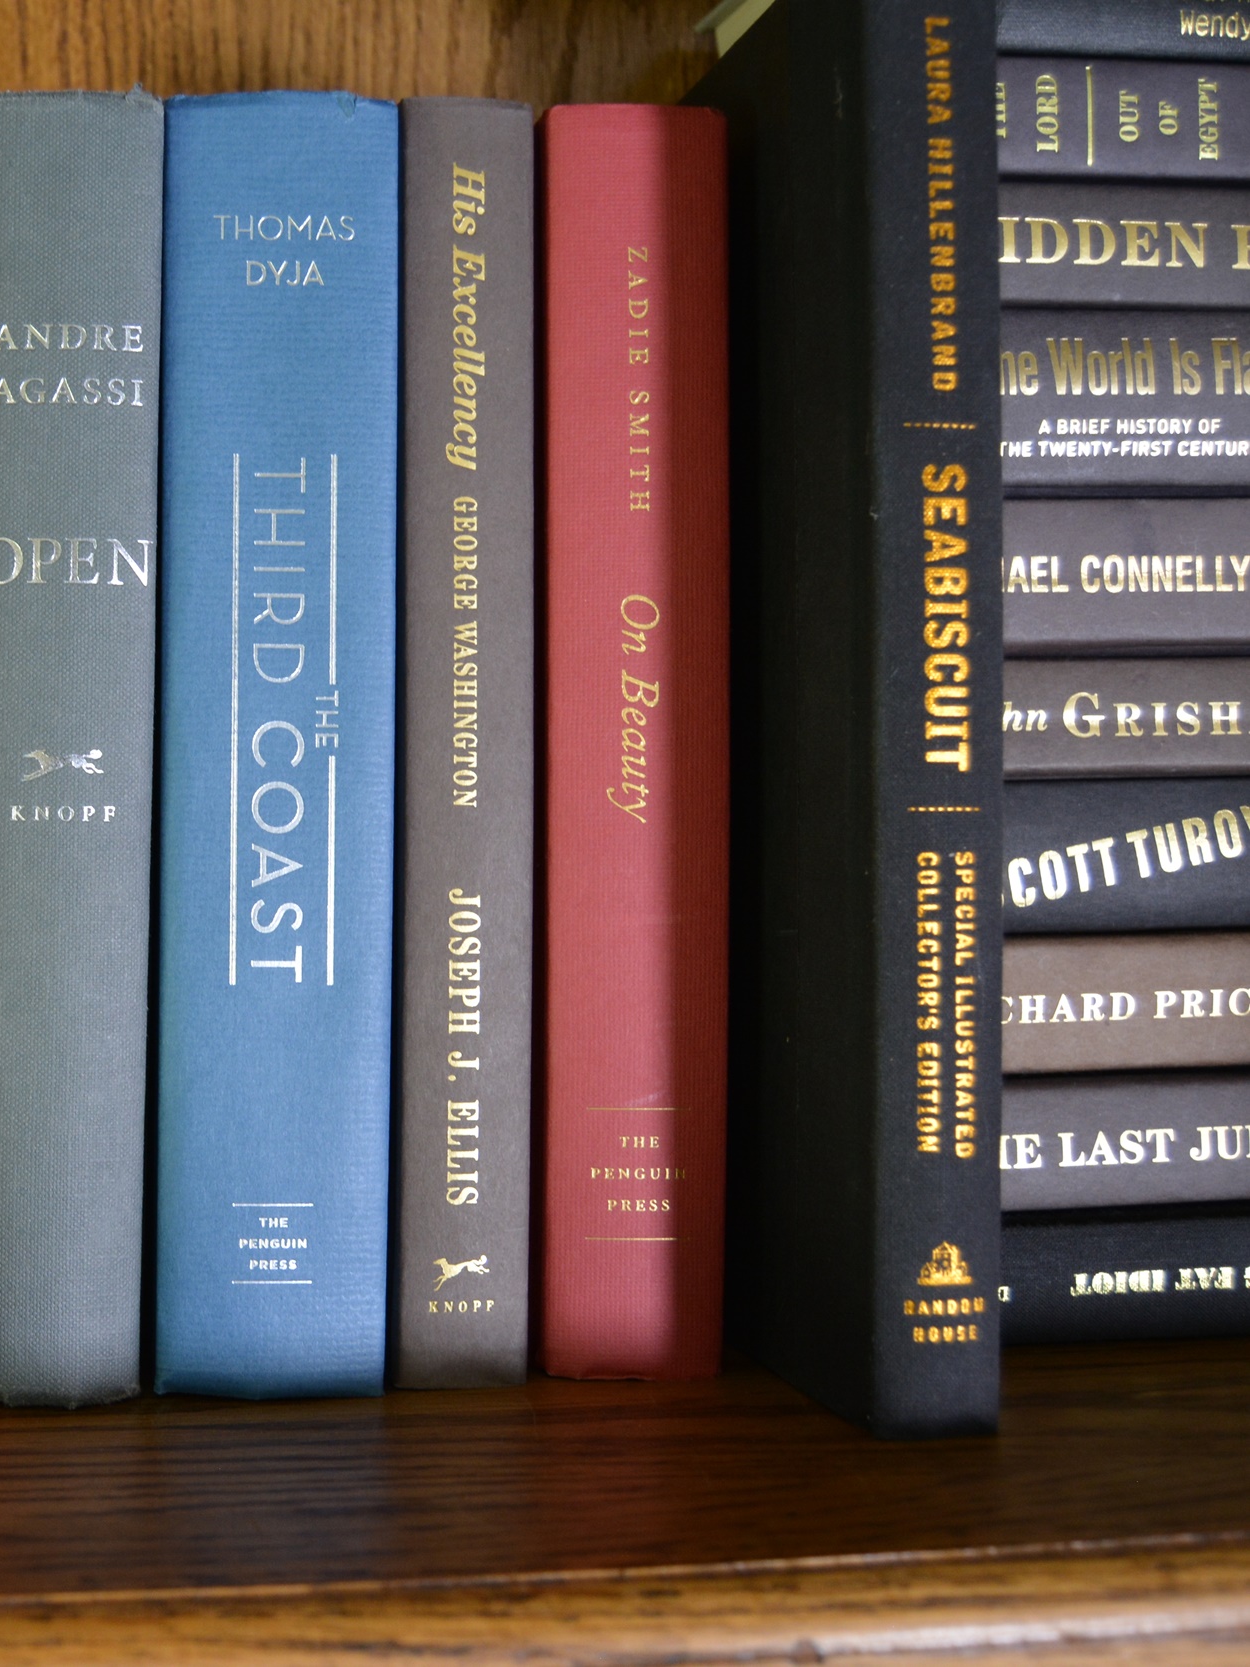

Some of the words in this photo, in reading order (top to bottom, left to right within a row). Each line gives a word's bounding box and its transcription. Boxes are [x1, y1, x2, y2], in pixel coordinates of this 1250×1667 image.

[1181, 11, 1250, 41] Wendy
[924, 16, 953, 125] LAURA
[1036, 74, 1059, 152] LORD
[1119, 90, 1140, 142] OUT
[1159, 101, 1178, 135] OF
[1198, 78, 1220, 160] EGYPT
[451, 161, 486, 236] His
[214, 215, 355, 241] THOMAS
[998, 216, 1208, 268] IDDEN
[246, 260, 324, 286] DYJA
[927, 137, 959, 392] HILLENBRAND
[626, 246, 650, 365] ZADIE
[445, 243, 486, 471] Excellency
[1047, 338, 1157, 396] World
[1170, 338, 1202, 396] Is
[628, 390, 651, 512] SMITH
[1038, 419, 1050, 434] A
[1057, 418, 1110, 434] BRIEF
[1116, 418, 1193, 434] HISTORY
[1198, 418, 1221, 434] OF
[1038, 440, 1173, 457] TWENTY-FIRST
[253, 457, 306, 683] THIRD
[453, 496, 478, 609] GEORGE
[1002, 555, 1070, 593] AEL
[1081, 555, 1250, 593] CONNELLY
[620, 594, 660, 654] On
[922, 465, 970, 772] SEABISCUIT
[315, 690, 339, 748] THE
[453, 621, 478, 807] WASHINGTON
[1062, 692, 1250, 738] GRISH
[606, 671, 660, 823] Beauty
[12, 805, 116, 822] KNOPF
[250, 721, 304, 983] COAST
[1002, 837, 1117, 908] COTT
[1126, 806, 1250, 878] TURO
[955, 851, 975, 966] SPECIAL
[447, 888, 482, 1035] JOSEPH
[917, 852, 941, 1030] COLLECTOR'S
[447, 1050, 481, 1082] J.
[955, 976, 975, 1158] ILLUSTRATED
[917, 1042, 941, 1152] EDITION
[445, 1099, 480, 1206] ELLIS
[619, 1136, 660, 1149] THE
[1058, 1128, 1175, 1167] LAST
[1190, 1125, 1250, 1161] JU
[590, 1167, 686, 1180] PENGUIN
[259, 1217, 288, 1228] THE
[607, 1199, 671, 1212] PRESS
[239, 1238, 307, 1249] PENGUIN
[249, 1259, 297, 1270] PRESS
[429, 1300, 494, 1312] KNOPF
[904, 1297, 984, 1316] RANDOM
[1070, 1269, 1166, 1296] IDIOT
[1175, 1266, 1237, 1292] FAT
[913, 1325, 977, 1343] HOUSE
